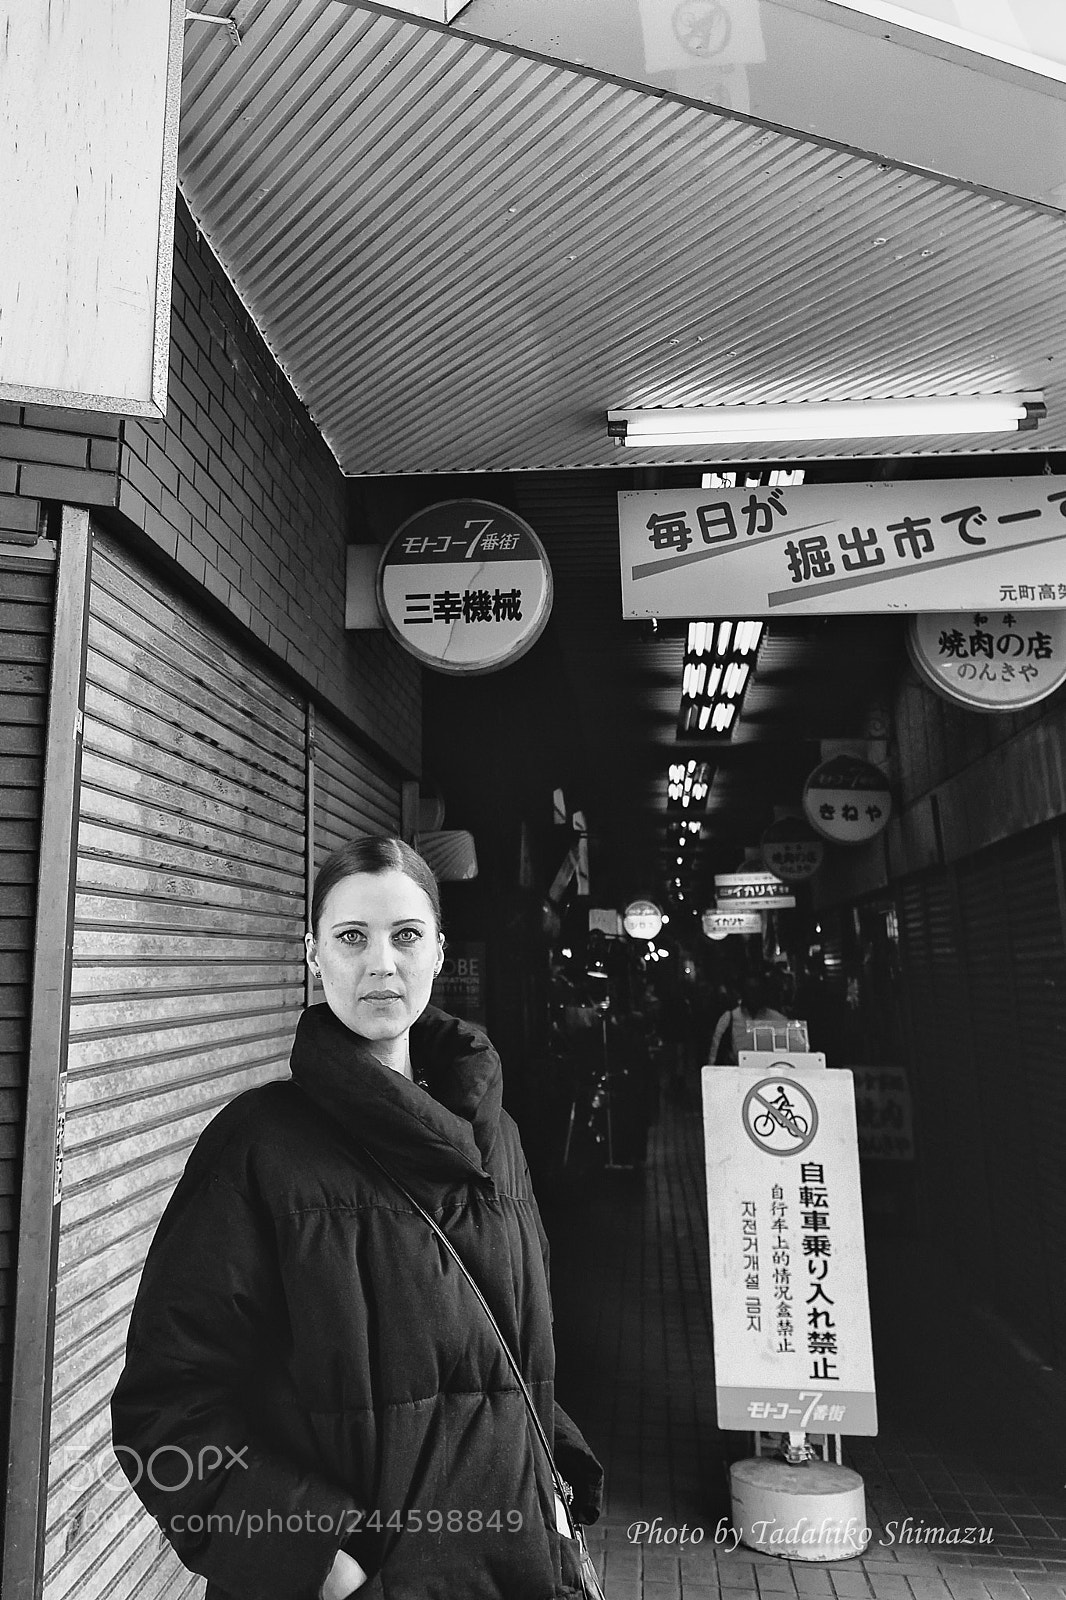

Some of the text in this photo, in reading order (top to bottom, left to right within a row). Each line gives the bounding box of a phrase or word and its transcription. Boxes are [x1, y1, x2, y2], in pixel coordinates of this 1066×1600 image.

[646, 488, 788, 551] 毎日が
[401, 518, 521, 559] モトコー7番街
[403, 588, 523, 625] 三幸機械
[938, 630, 1054, 660] 焼肉の店
[957, 661, 1039, 684] のんきや
[819, 802, 883, 822] きねや
[798, 1161, 840, 1381] 自転車乗り入れ禁止
[745, 1295, 762, 1333] 금지
[746, 1391, 847, 1428] モトコー7番街
